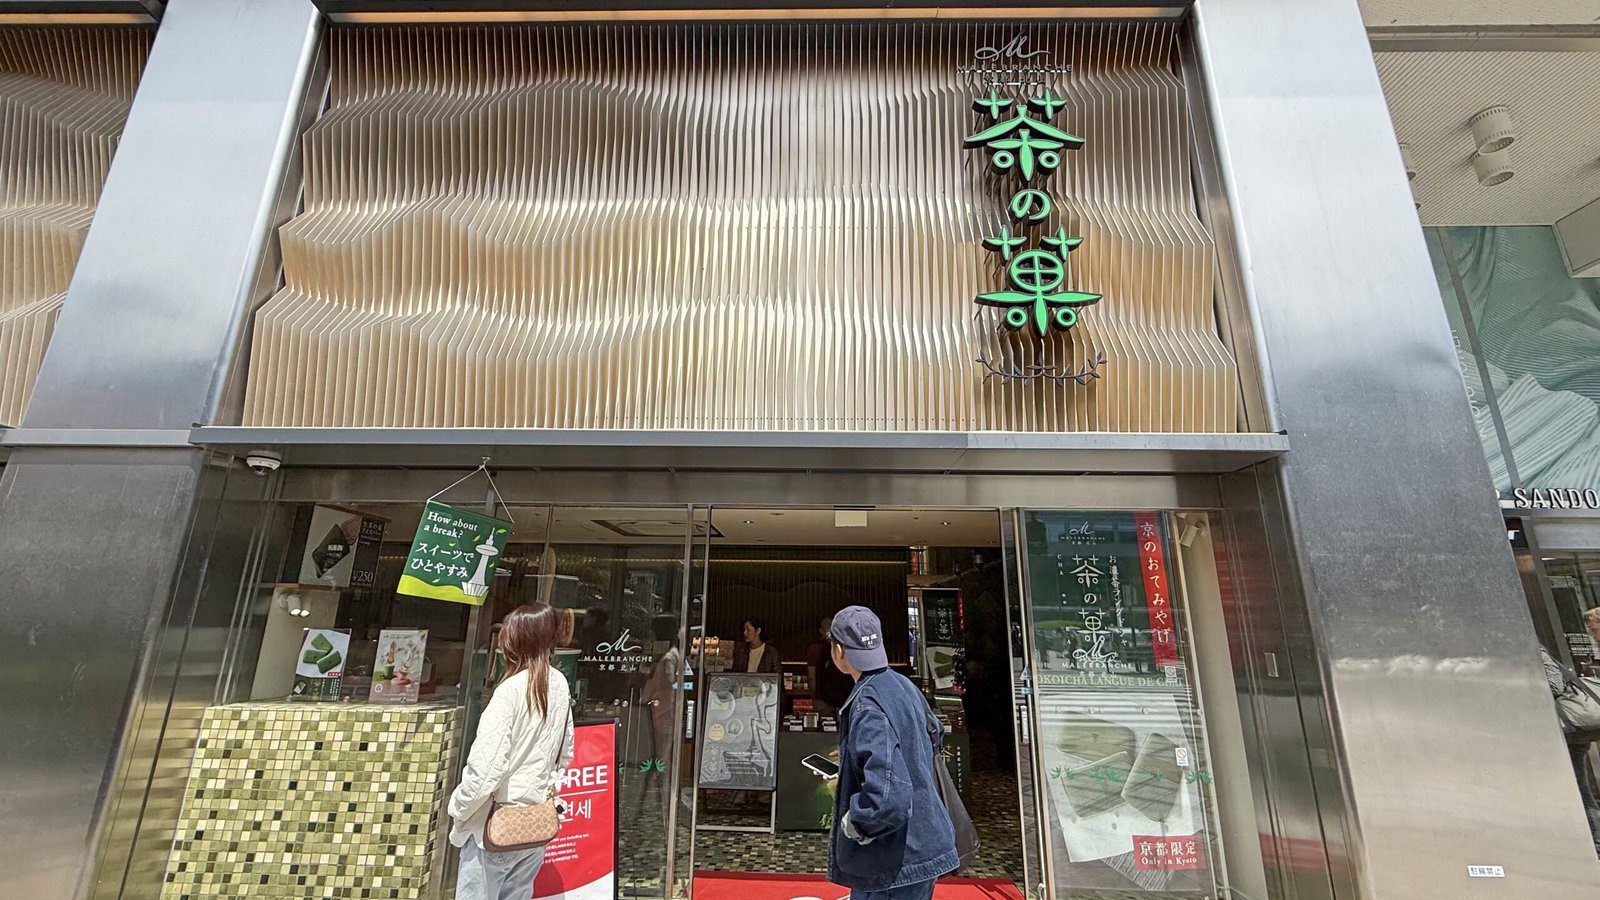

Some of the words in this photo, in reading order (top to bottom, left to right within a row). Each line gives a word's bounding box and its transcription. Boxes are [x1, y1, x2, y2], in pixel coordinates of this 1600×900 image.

[957, 63, 1073, 72] MALEBRANCHE
[963, 87, 1103, 337] 茶の菓
[427, 511, 451, 525] How
[452, 518, 478, 531] about
[432, 525, 464, 538] break?
[415, 542, 475, 563] スイーツで
[411, 557, 468, 577] ひとやすみ
[1140, 522, 1172, 643] 京のおてみやげ
[1090, 675, 1135, 686] LANGUE
[566, 765, 608, 788] REE
[1139, 841, 1197, 856] 京都限定
[1141, 857, 1161, 867] Only
[1176, 857, 1197, 867] Kyoto
